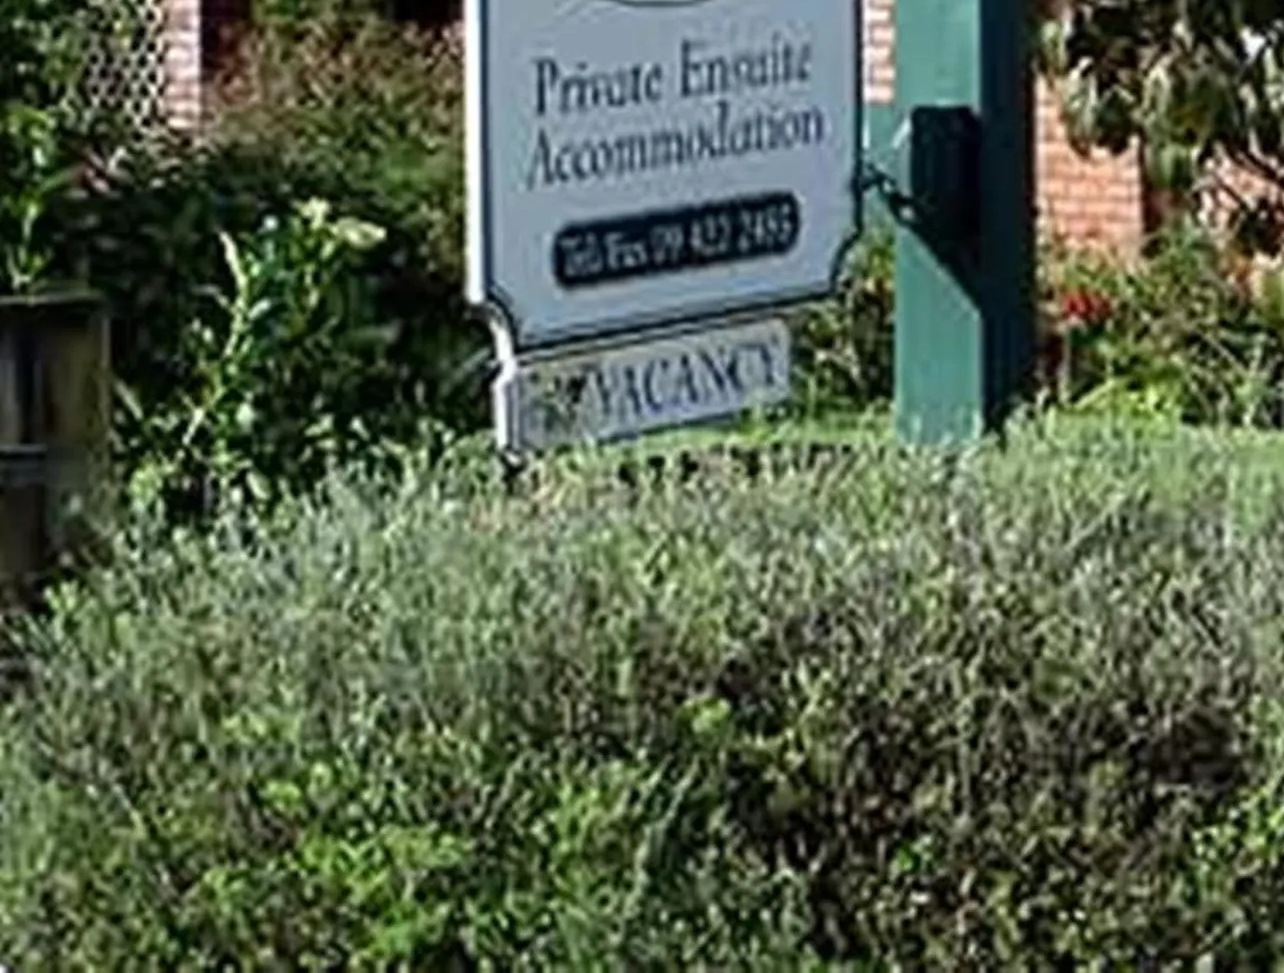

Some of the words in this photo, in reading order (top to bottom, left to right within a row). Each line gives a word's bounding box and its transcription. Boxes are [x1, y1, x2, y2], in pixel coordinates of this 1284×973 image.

[532, 57, 662, 116] Private
[679, 32, 811, 98] Ensuite
[526, 102, 825, 190] Accommodation
[592, 332, 783, 417] VACANCY
